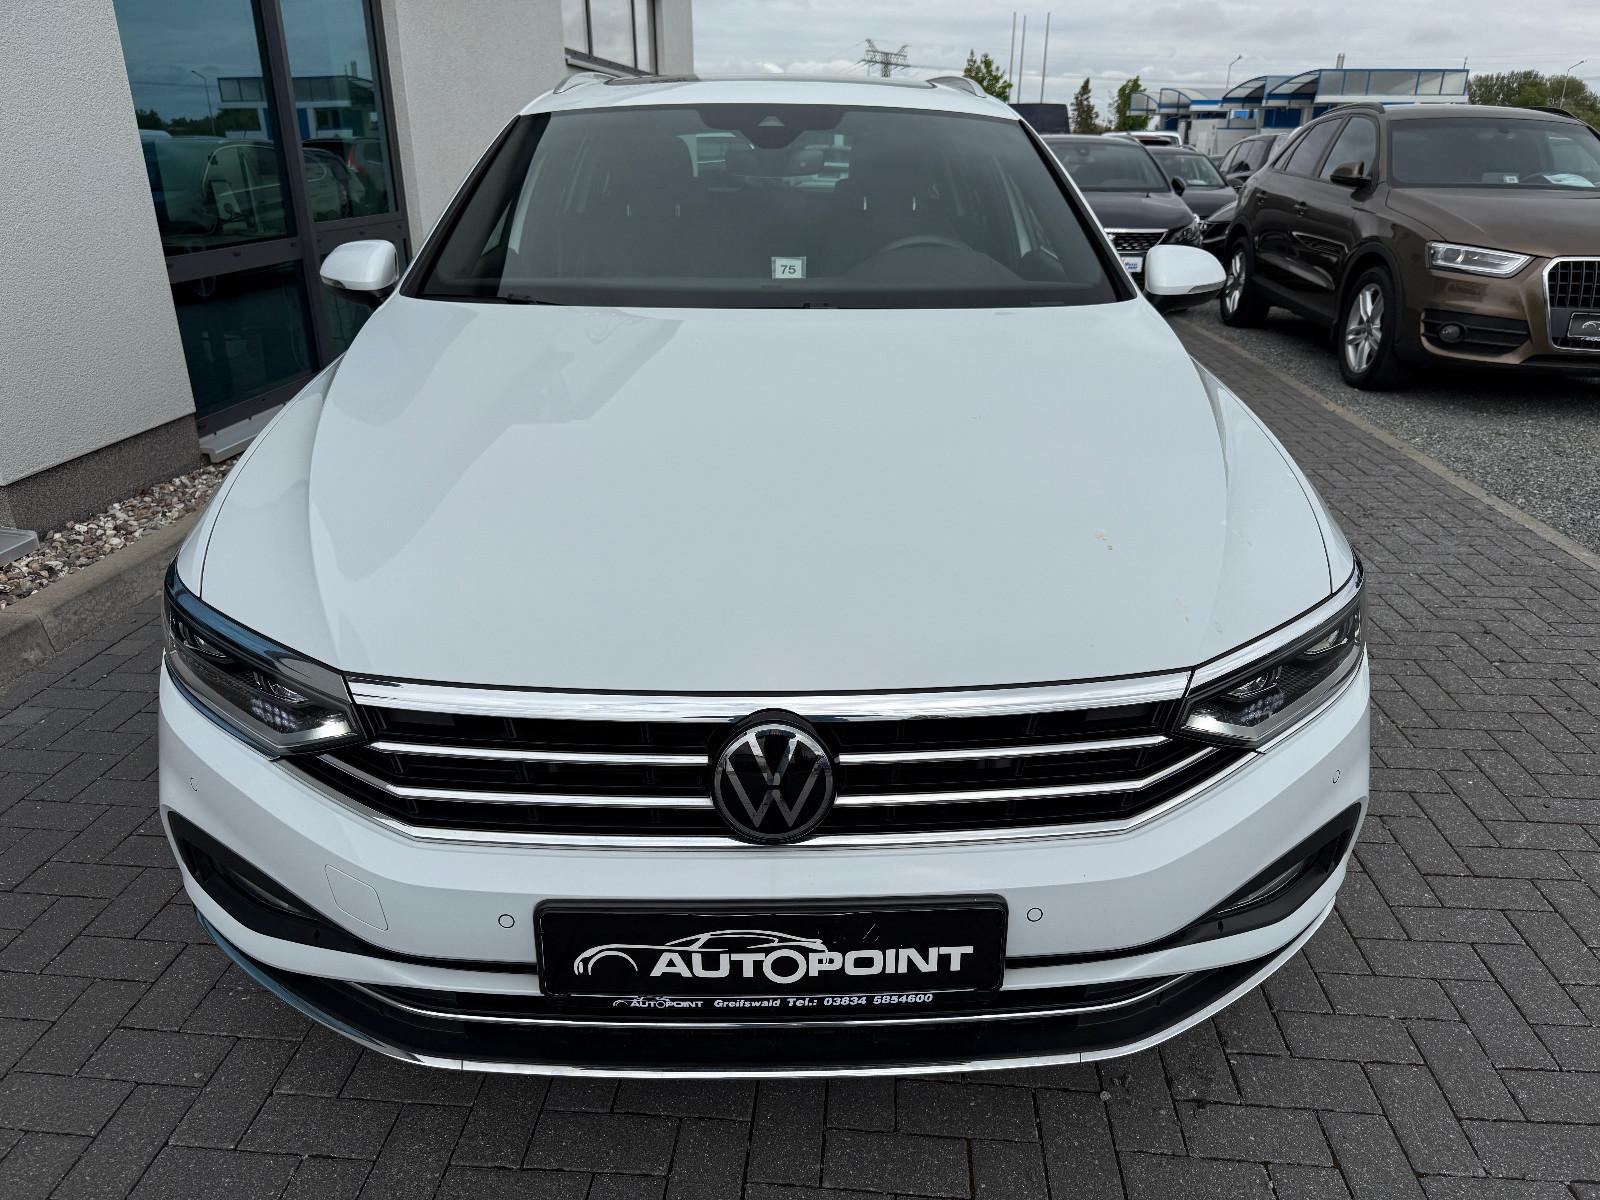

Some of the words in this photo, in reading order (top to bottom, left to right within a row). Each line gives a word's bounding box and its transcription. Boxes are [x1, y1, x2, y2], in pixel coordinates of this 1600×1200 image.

[780, 264, 797, 275] 75
[649, 945, 974, 984] AUTOPOINT
[630, 1000, 704, 1009] AUTOPOINT
[713, 999, 781, 1008] Greifswald
[786, 998, 818, 1007] Tel.:
[823, 996, 868, 1006] 03834
[872, 993, 934, 1004] 5854600
